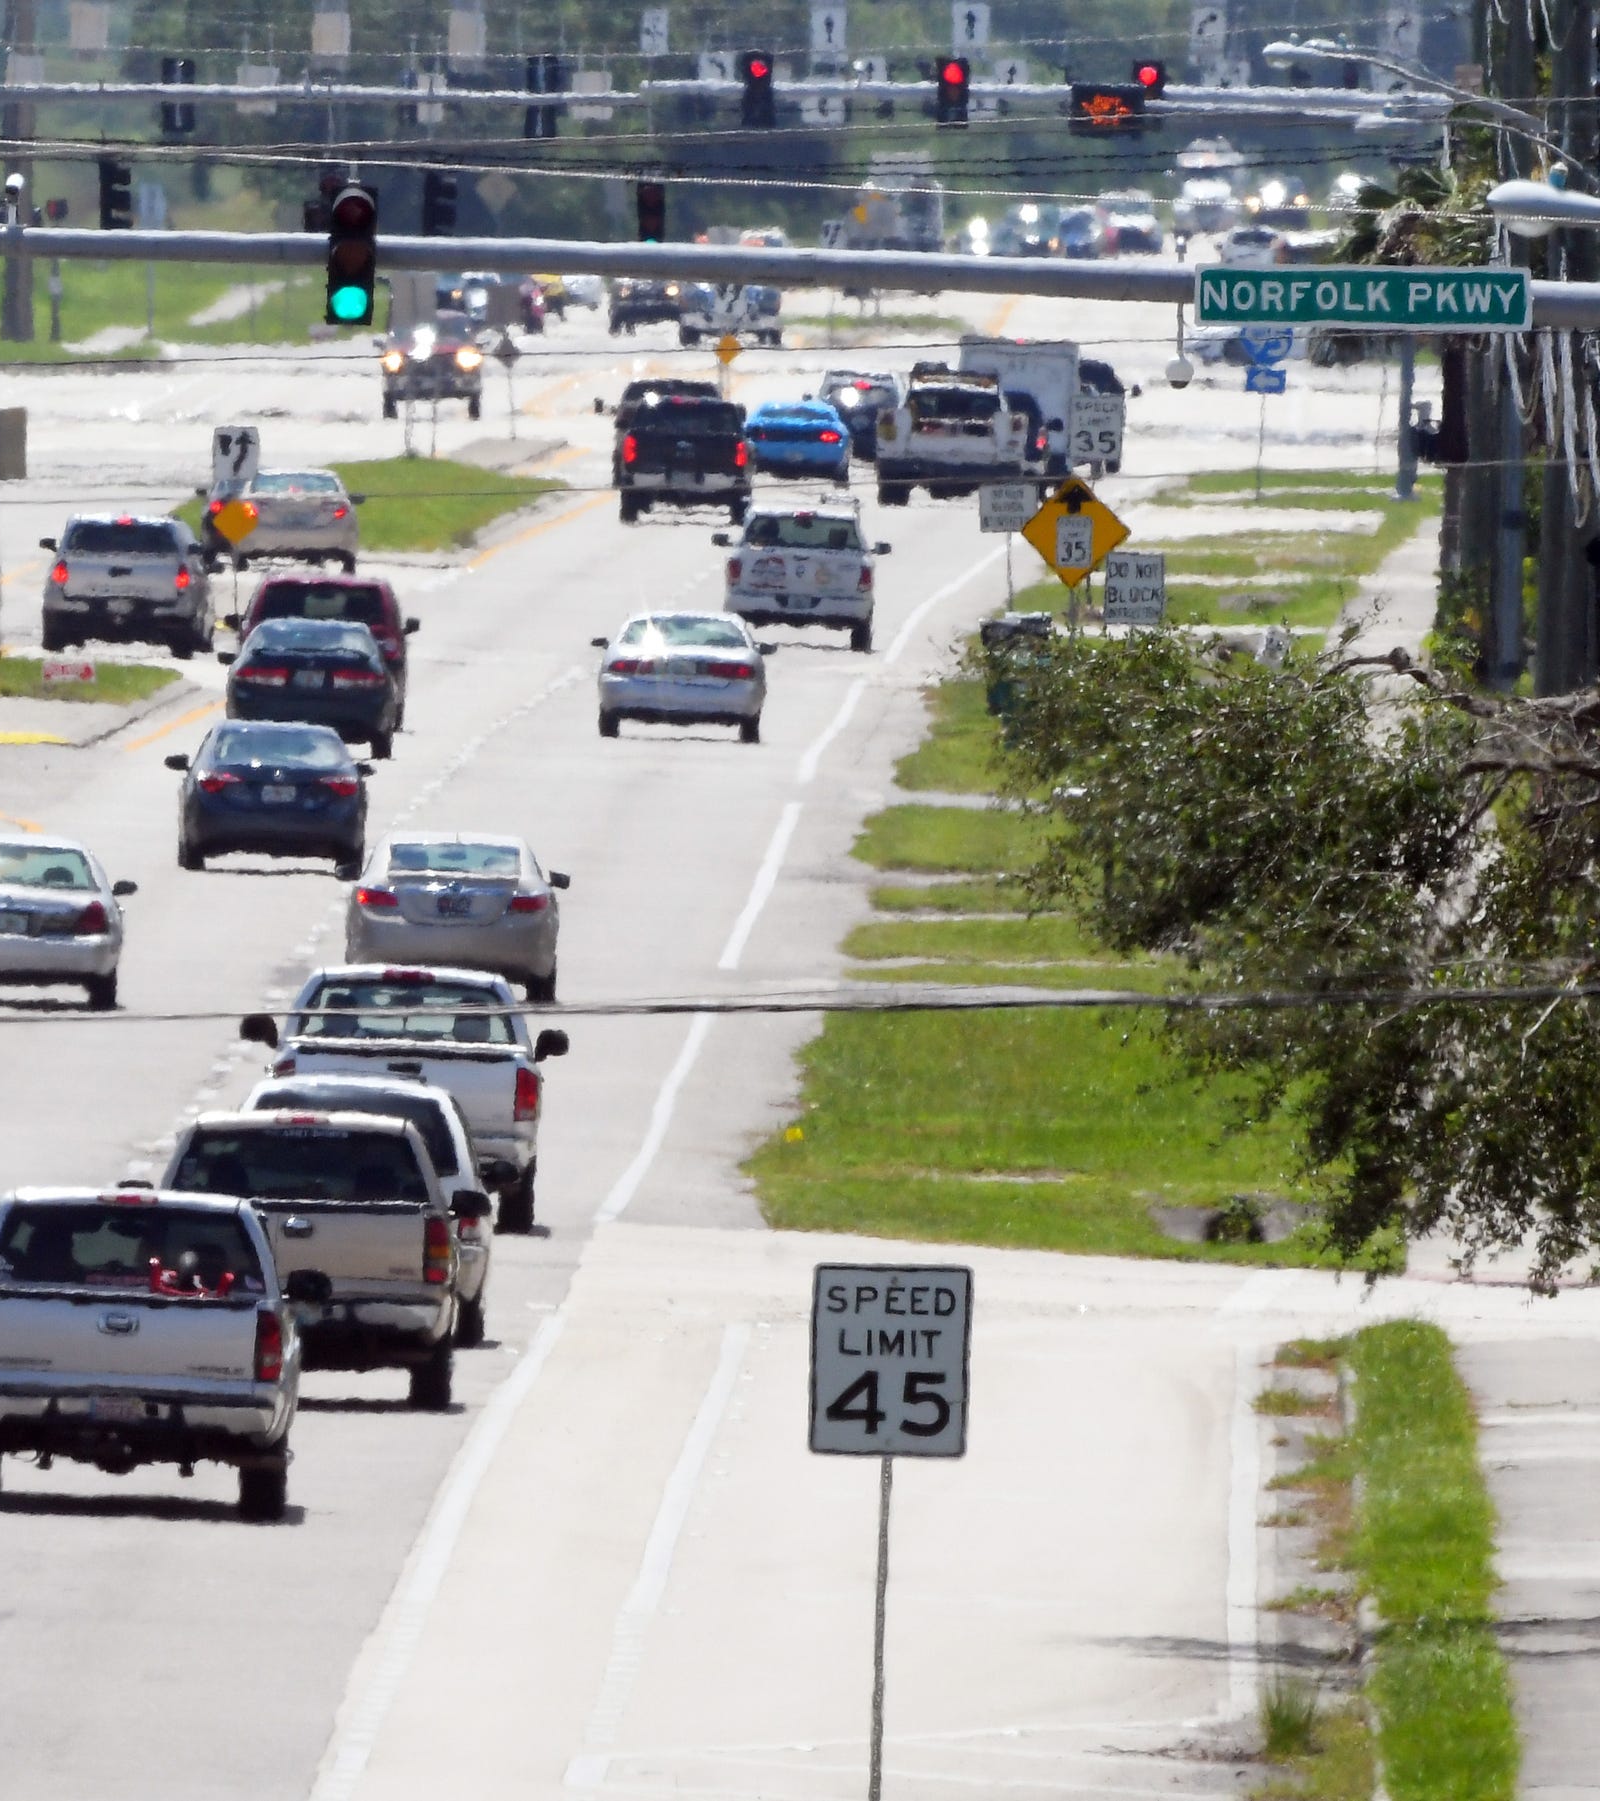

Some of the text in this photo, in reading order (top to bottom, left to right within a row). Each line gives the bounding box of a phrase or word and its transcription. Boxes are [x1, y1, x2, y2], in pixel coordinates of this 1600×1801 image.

[1202, 280, 1519, 315] NORFOLK PKWY
[1075, 430, 1116, 454] 35
[1061, 541, 1086, 562] 35
[1109, 561, 1159, 579] DO NOT
[1108, 586, 1161, 603] BLOCK
[827, 1286, 956, 1316] SPEED
[838, 1328, 942, 1358] LIMIT
[826, 1370, 950, 1437] 45
